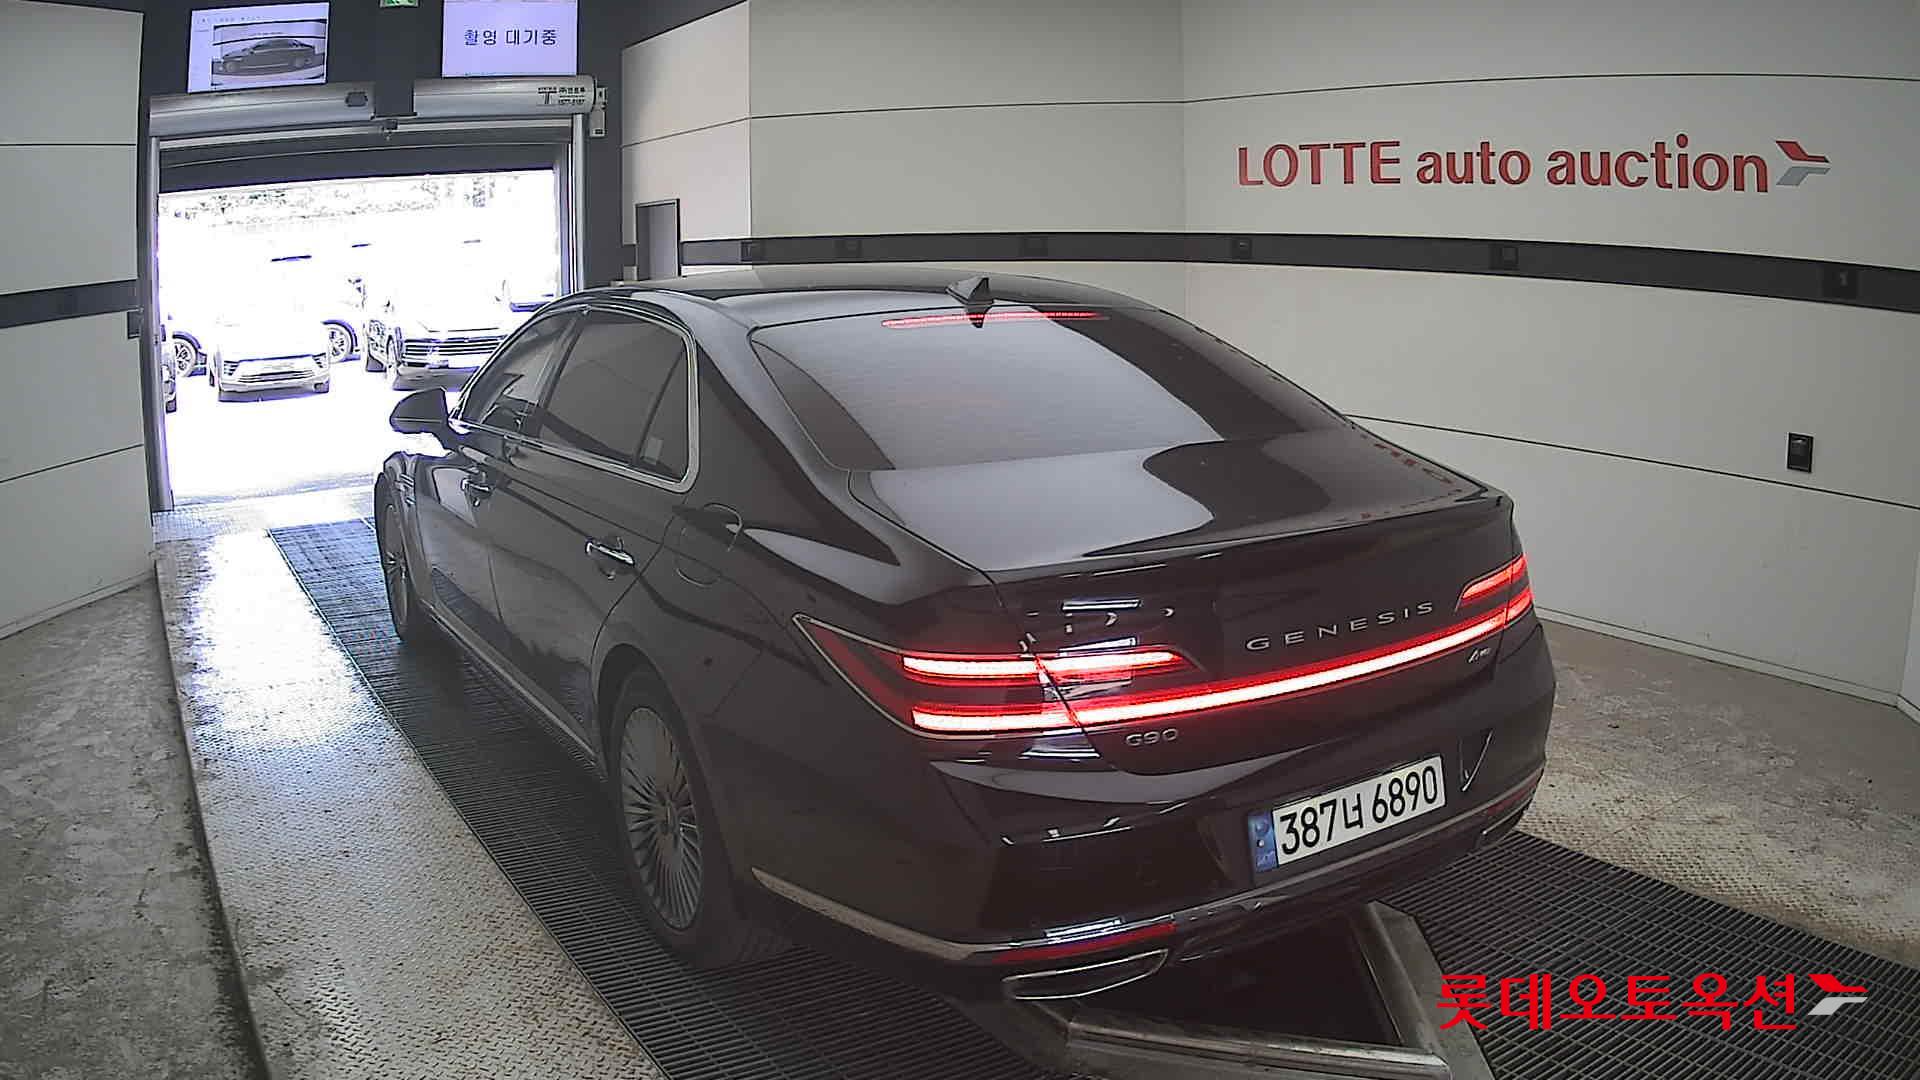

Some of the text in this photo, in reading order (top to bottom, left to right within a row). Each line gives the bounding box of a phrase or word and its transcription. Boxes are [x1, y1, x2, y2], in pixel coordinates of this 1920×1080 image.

[464, 29, 557, 46] 촬영 대기중
[1238, 133, 1768, 193] LOTTE auto auction
[1246, 602, 1433, 650] GENESIS
[1126, 728, 1178, 746] G90
[1279, 765, 1438, 855] 387너 6890
